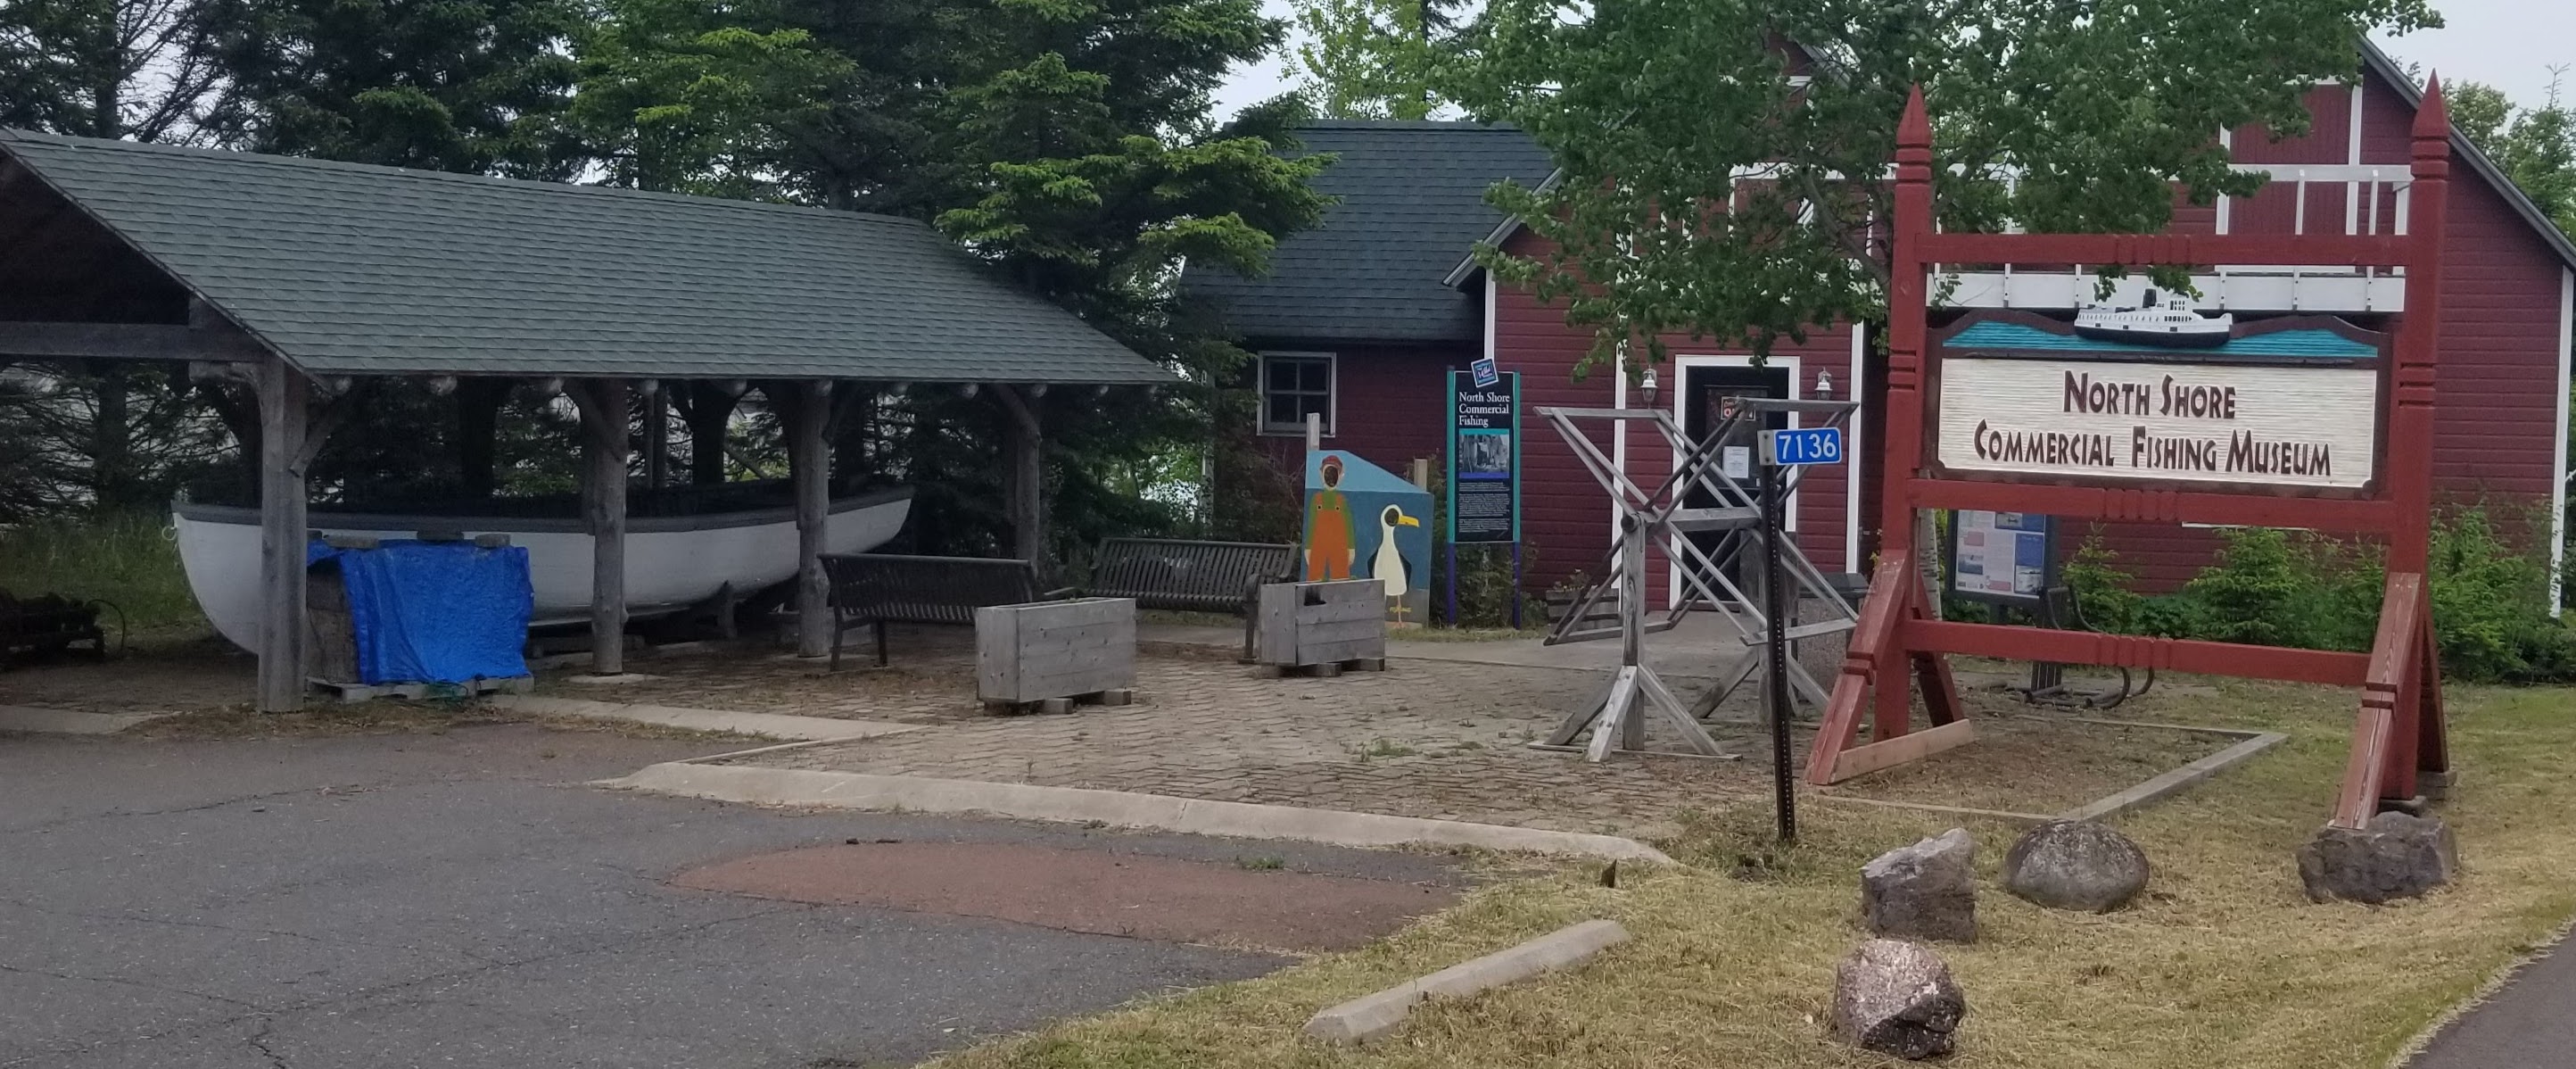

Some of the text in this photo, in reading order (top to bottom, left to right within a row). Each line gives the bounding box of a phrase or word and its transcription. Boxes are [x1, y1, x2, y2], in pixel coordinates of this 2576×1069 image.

[1458, 391, 1510, 402] North Shore
[2063, 369, 2236, 419] NORTH SHORE
[1458, 402, 1510, 414] Commercial
[1458, 414, 1489, 428] Fishing
[1778, 433, 1837, 460] 7136
[1974, 418, 2332, 476] COMMERCIAL FISHING MUSEUM
